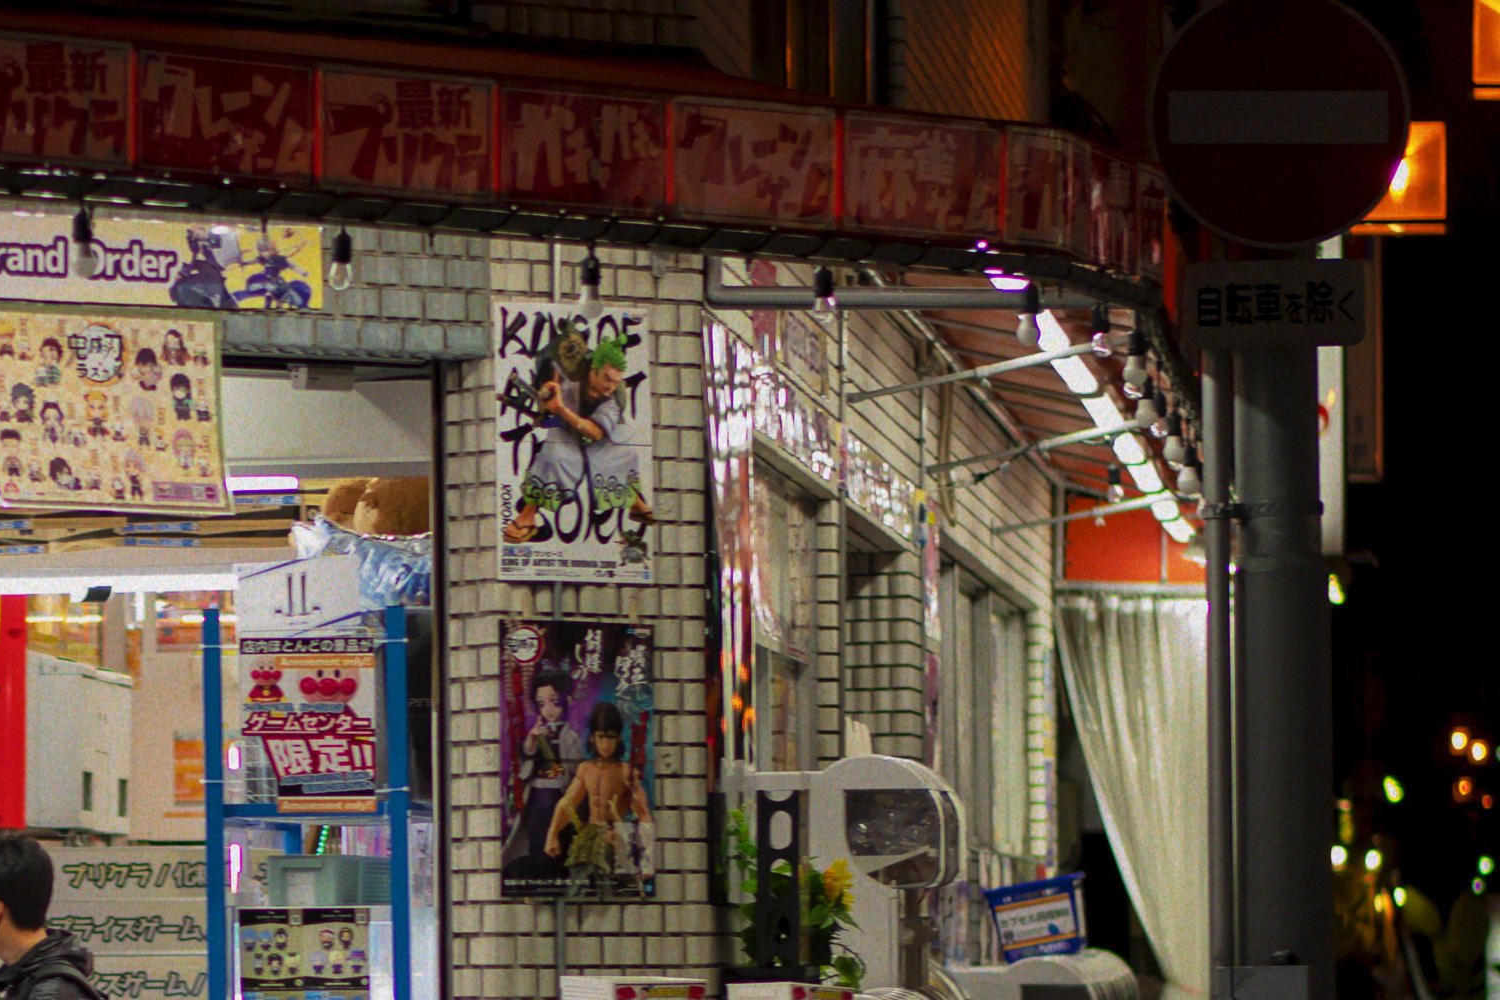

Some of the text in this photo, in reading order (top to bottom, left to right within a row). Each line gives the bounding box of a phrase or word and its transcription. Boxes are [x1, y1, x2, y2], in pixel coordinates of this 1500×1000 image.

[1197, 281, 1354, 327] 自転車を除く
[250, 712, 370, 732] ゲームセンター
[266, 735, 373, 777] 限定!!
